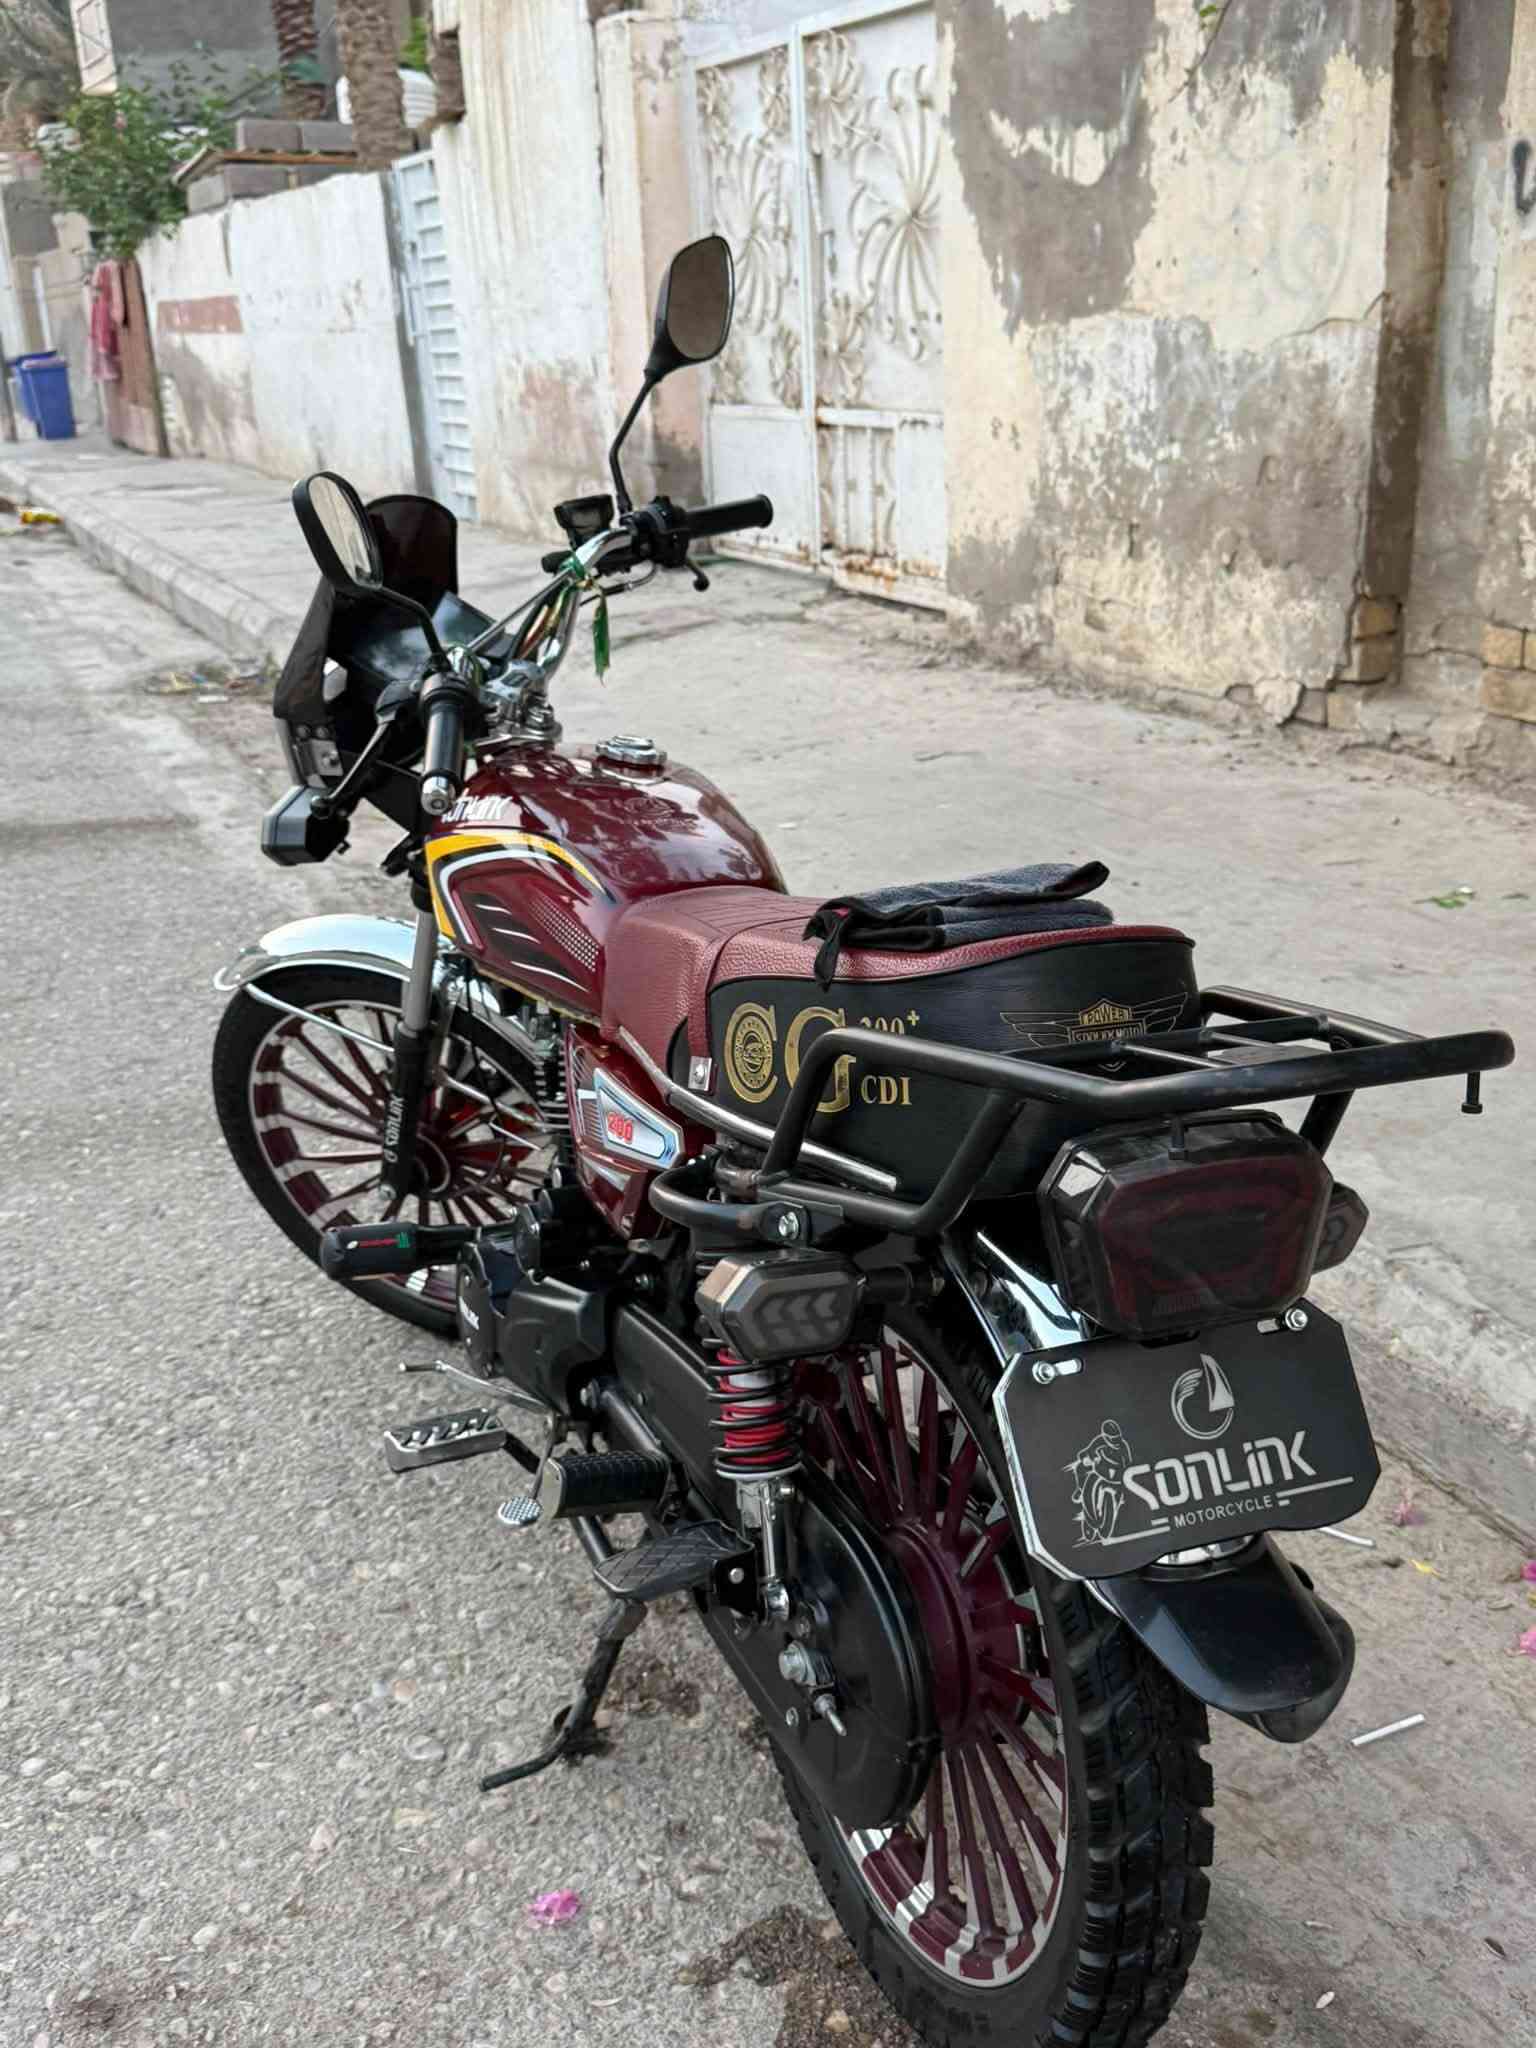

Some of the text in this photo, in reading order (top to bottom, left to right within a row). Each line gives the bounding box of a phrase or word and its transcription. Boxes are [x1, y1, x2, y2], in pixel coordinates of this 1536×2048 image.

[1087, 1004, 1126, 1024] POWER
[860, 1073, 912, 1105] CDI
[607, 1111, 633, 1144] 200
[1122, 1430, 1317, 1511] SONLINK
[1174, 1494, 1273, 1530] MOTORCYCLE
